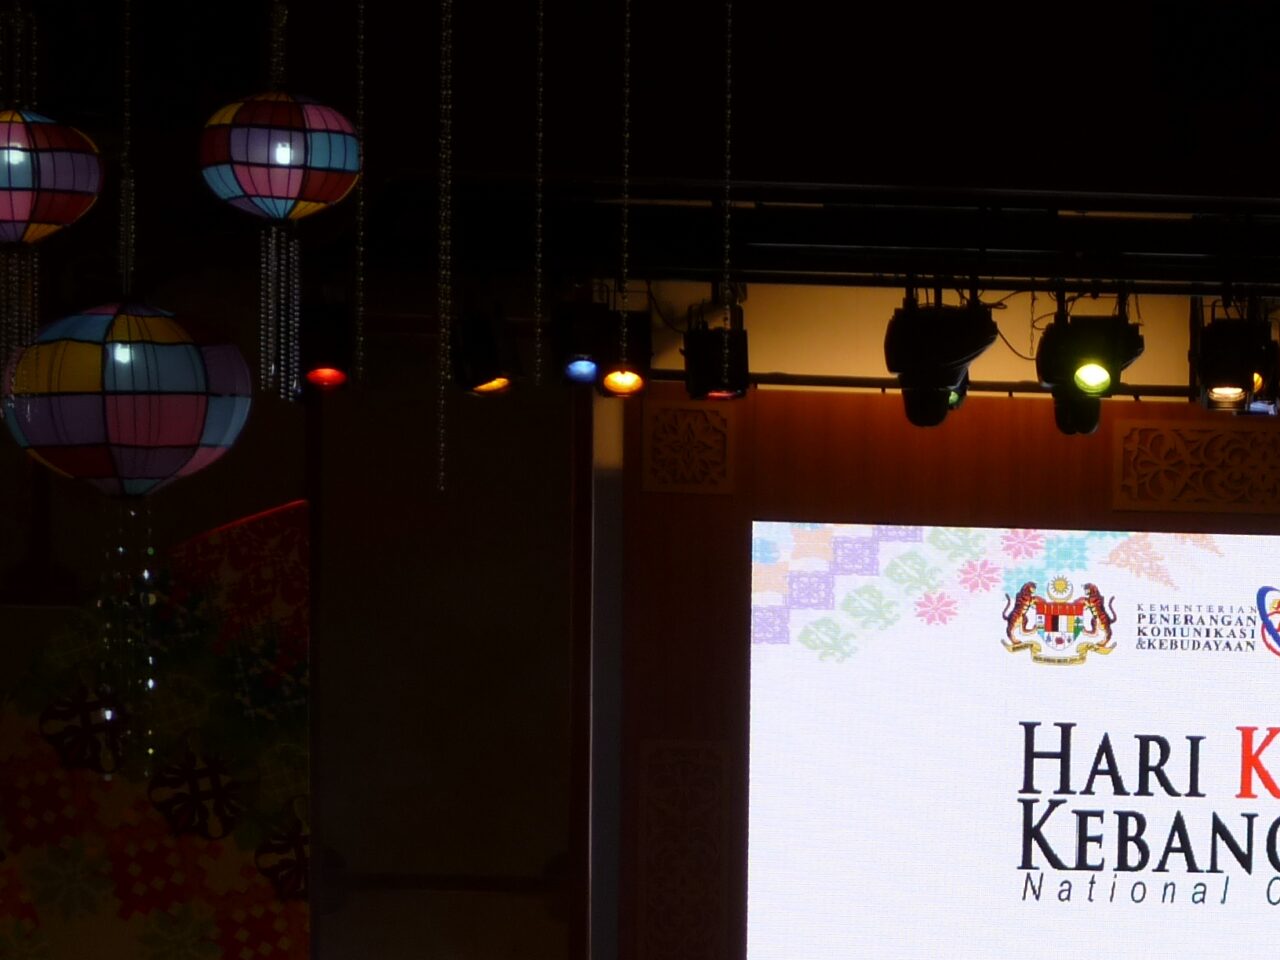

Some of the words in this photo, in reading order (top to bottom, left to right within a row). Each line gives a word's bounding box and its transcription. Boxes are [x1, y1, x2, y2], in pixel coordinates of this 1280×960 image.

[1137, 603, 1258, 614] KEMENTERIAN
[1137, 613, 1257, 627] PENERANGAN
[1137, 626, 1255, 639] KOMUNIKASI
[1135, 638, 1256, 652] &KEBUDAYAAN
[1018, 721, 1206, 797] HARI
[1022, 872, 1230, 904] National
